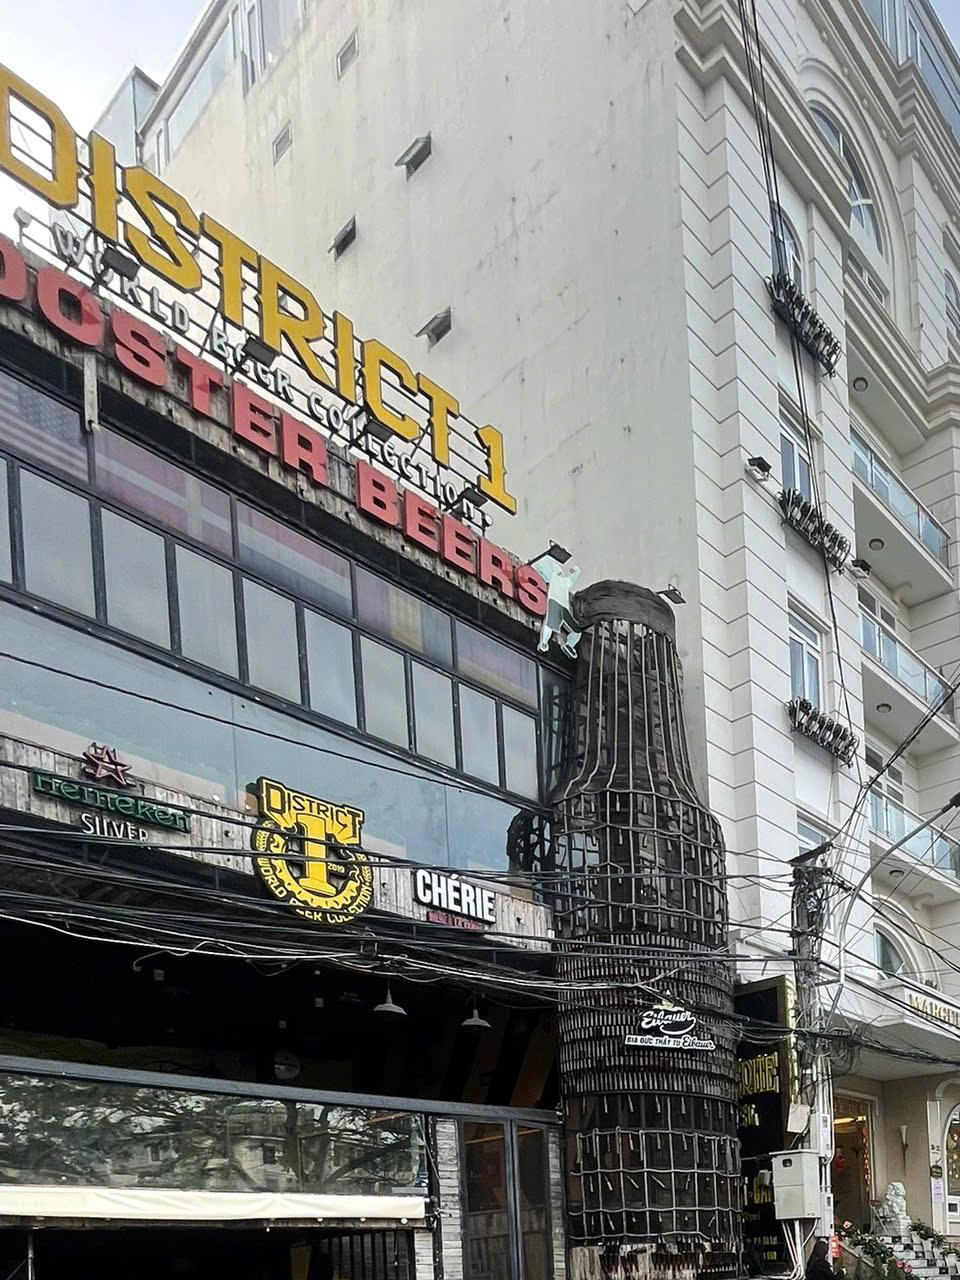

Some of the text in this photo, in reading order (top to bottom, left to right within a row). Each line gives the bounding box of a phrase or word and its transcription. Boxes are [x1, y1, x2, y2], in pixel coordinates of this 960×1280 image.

[0, 62, 518, 516] DISTRICT 1
[356, 460, 550, 616] BEERS
[265, 782, 361, 840] DISTRICT
[257, 857, 289, 899] WORLD
[416, 869, 497, 923] CHÉRIE
